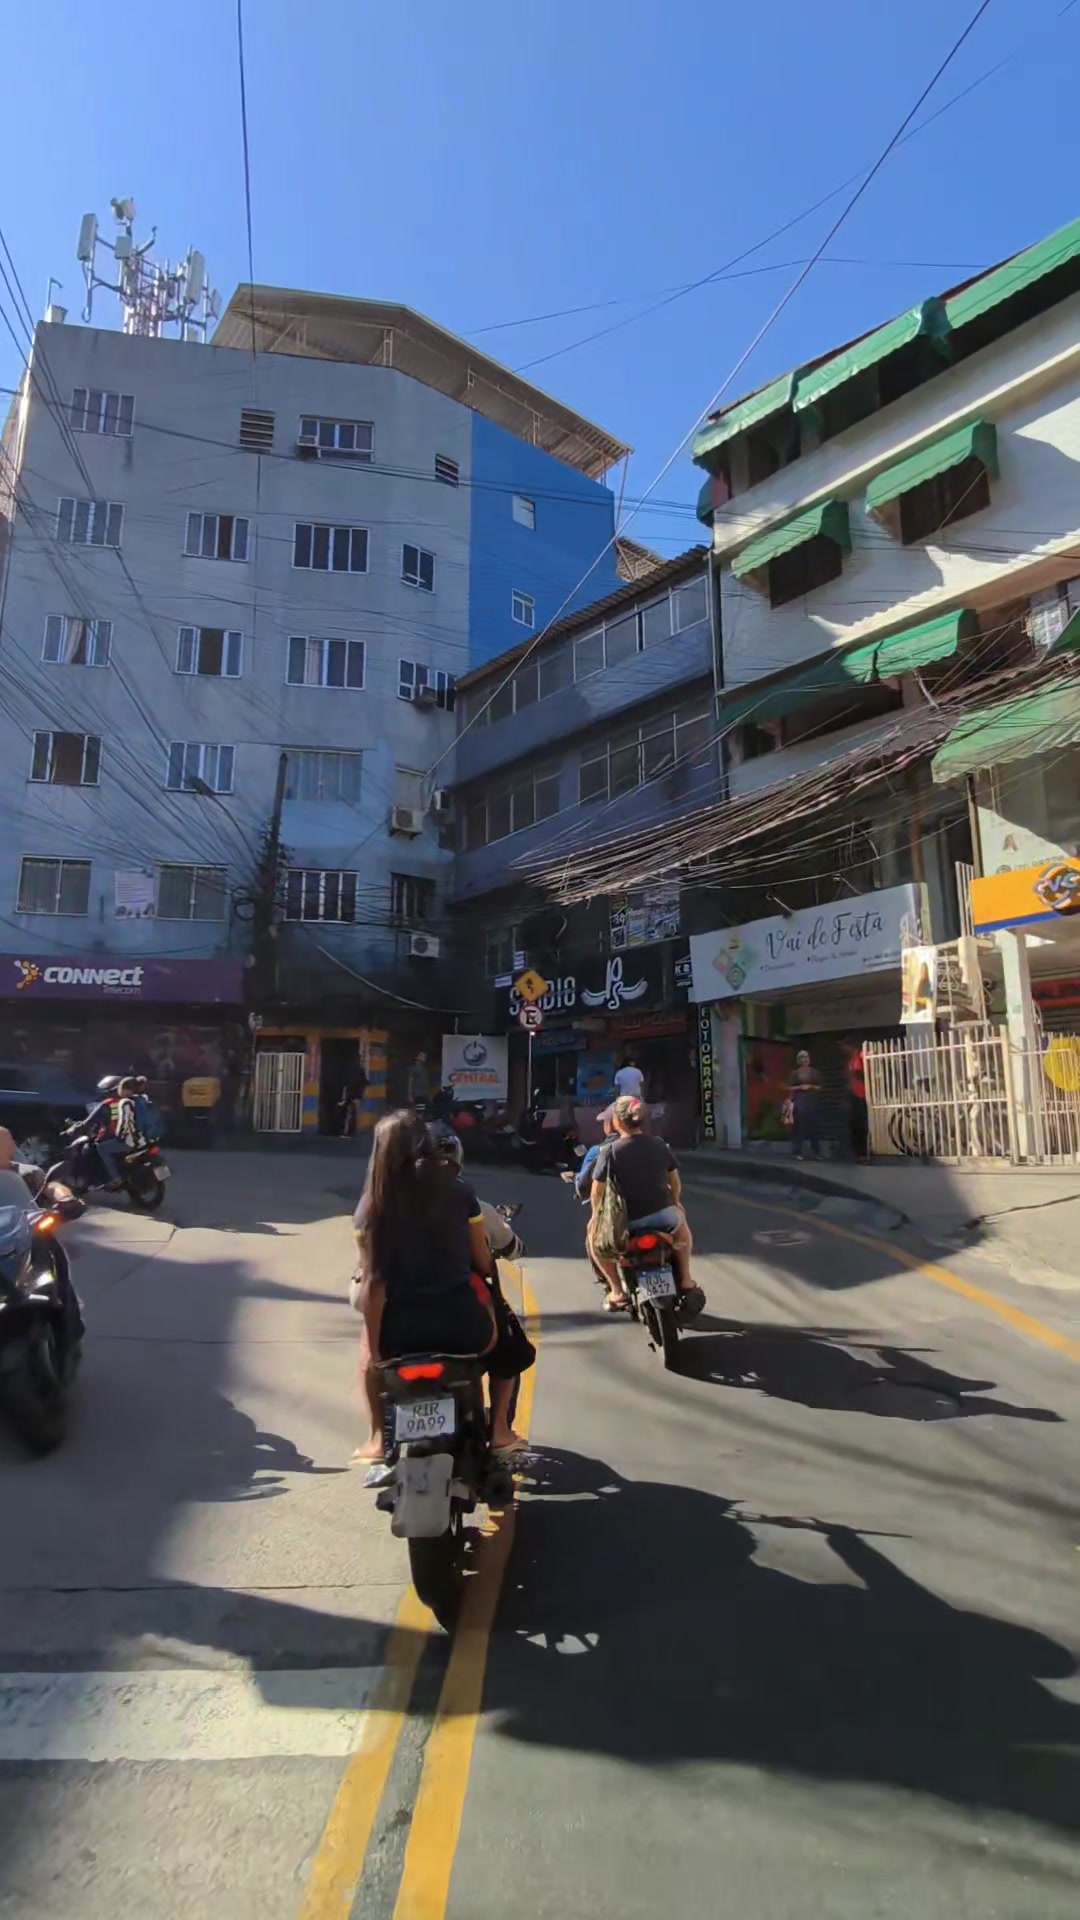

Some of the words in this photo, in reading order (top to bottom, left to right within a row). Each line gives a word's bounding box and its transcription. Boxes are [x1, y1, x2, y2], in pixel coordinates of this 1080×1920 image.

[765, 930, 801, 960] Vai
[807, 916, 829, 950] de
[831, 911, 884, 946] Festa
[509, 976, 576, 1016] SDIO
